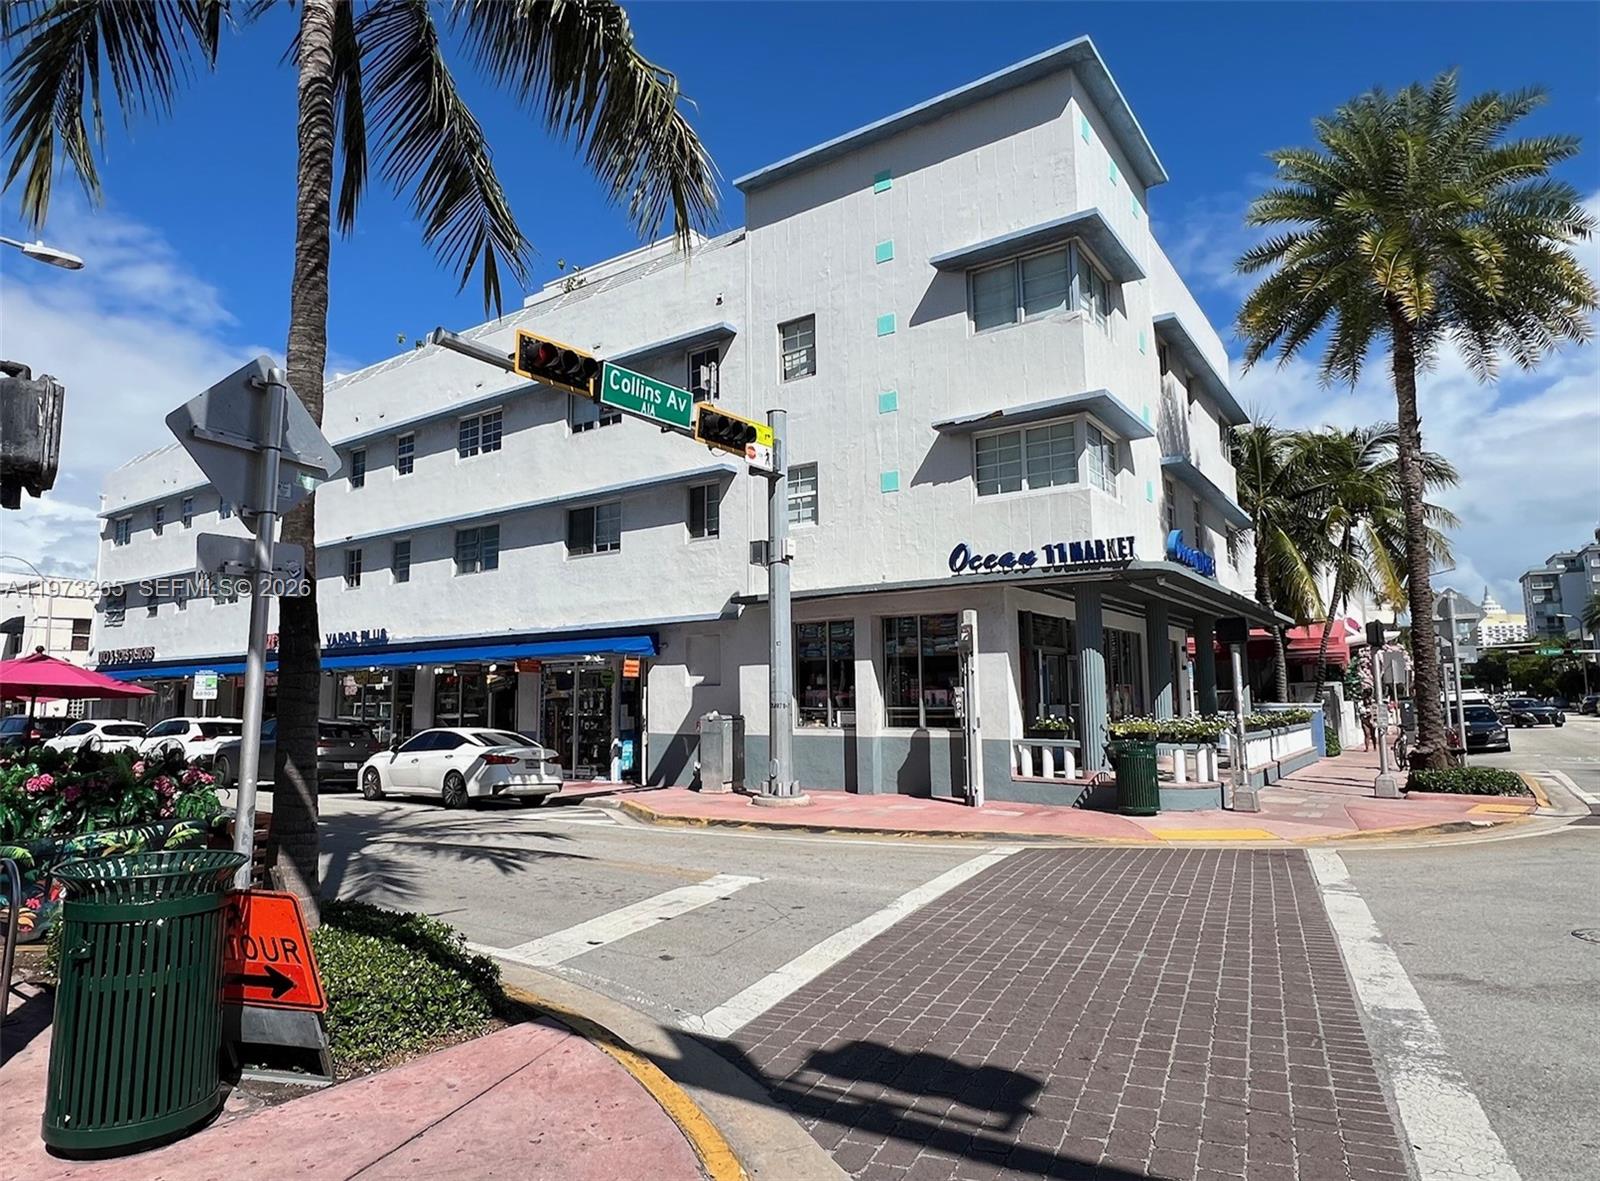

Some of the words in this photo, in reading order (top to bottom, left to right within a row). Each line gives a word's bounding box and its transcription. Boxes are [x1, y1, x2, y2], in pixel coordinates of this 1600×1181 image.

[609, 369, 662, 404] Collins
[666, 390, 687, 412] Av
[948, 542, 1038, 573] Ocean
[1069, 536, 1135, 561] MARKET
[228, 935, 302, 964] TOUR
